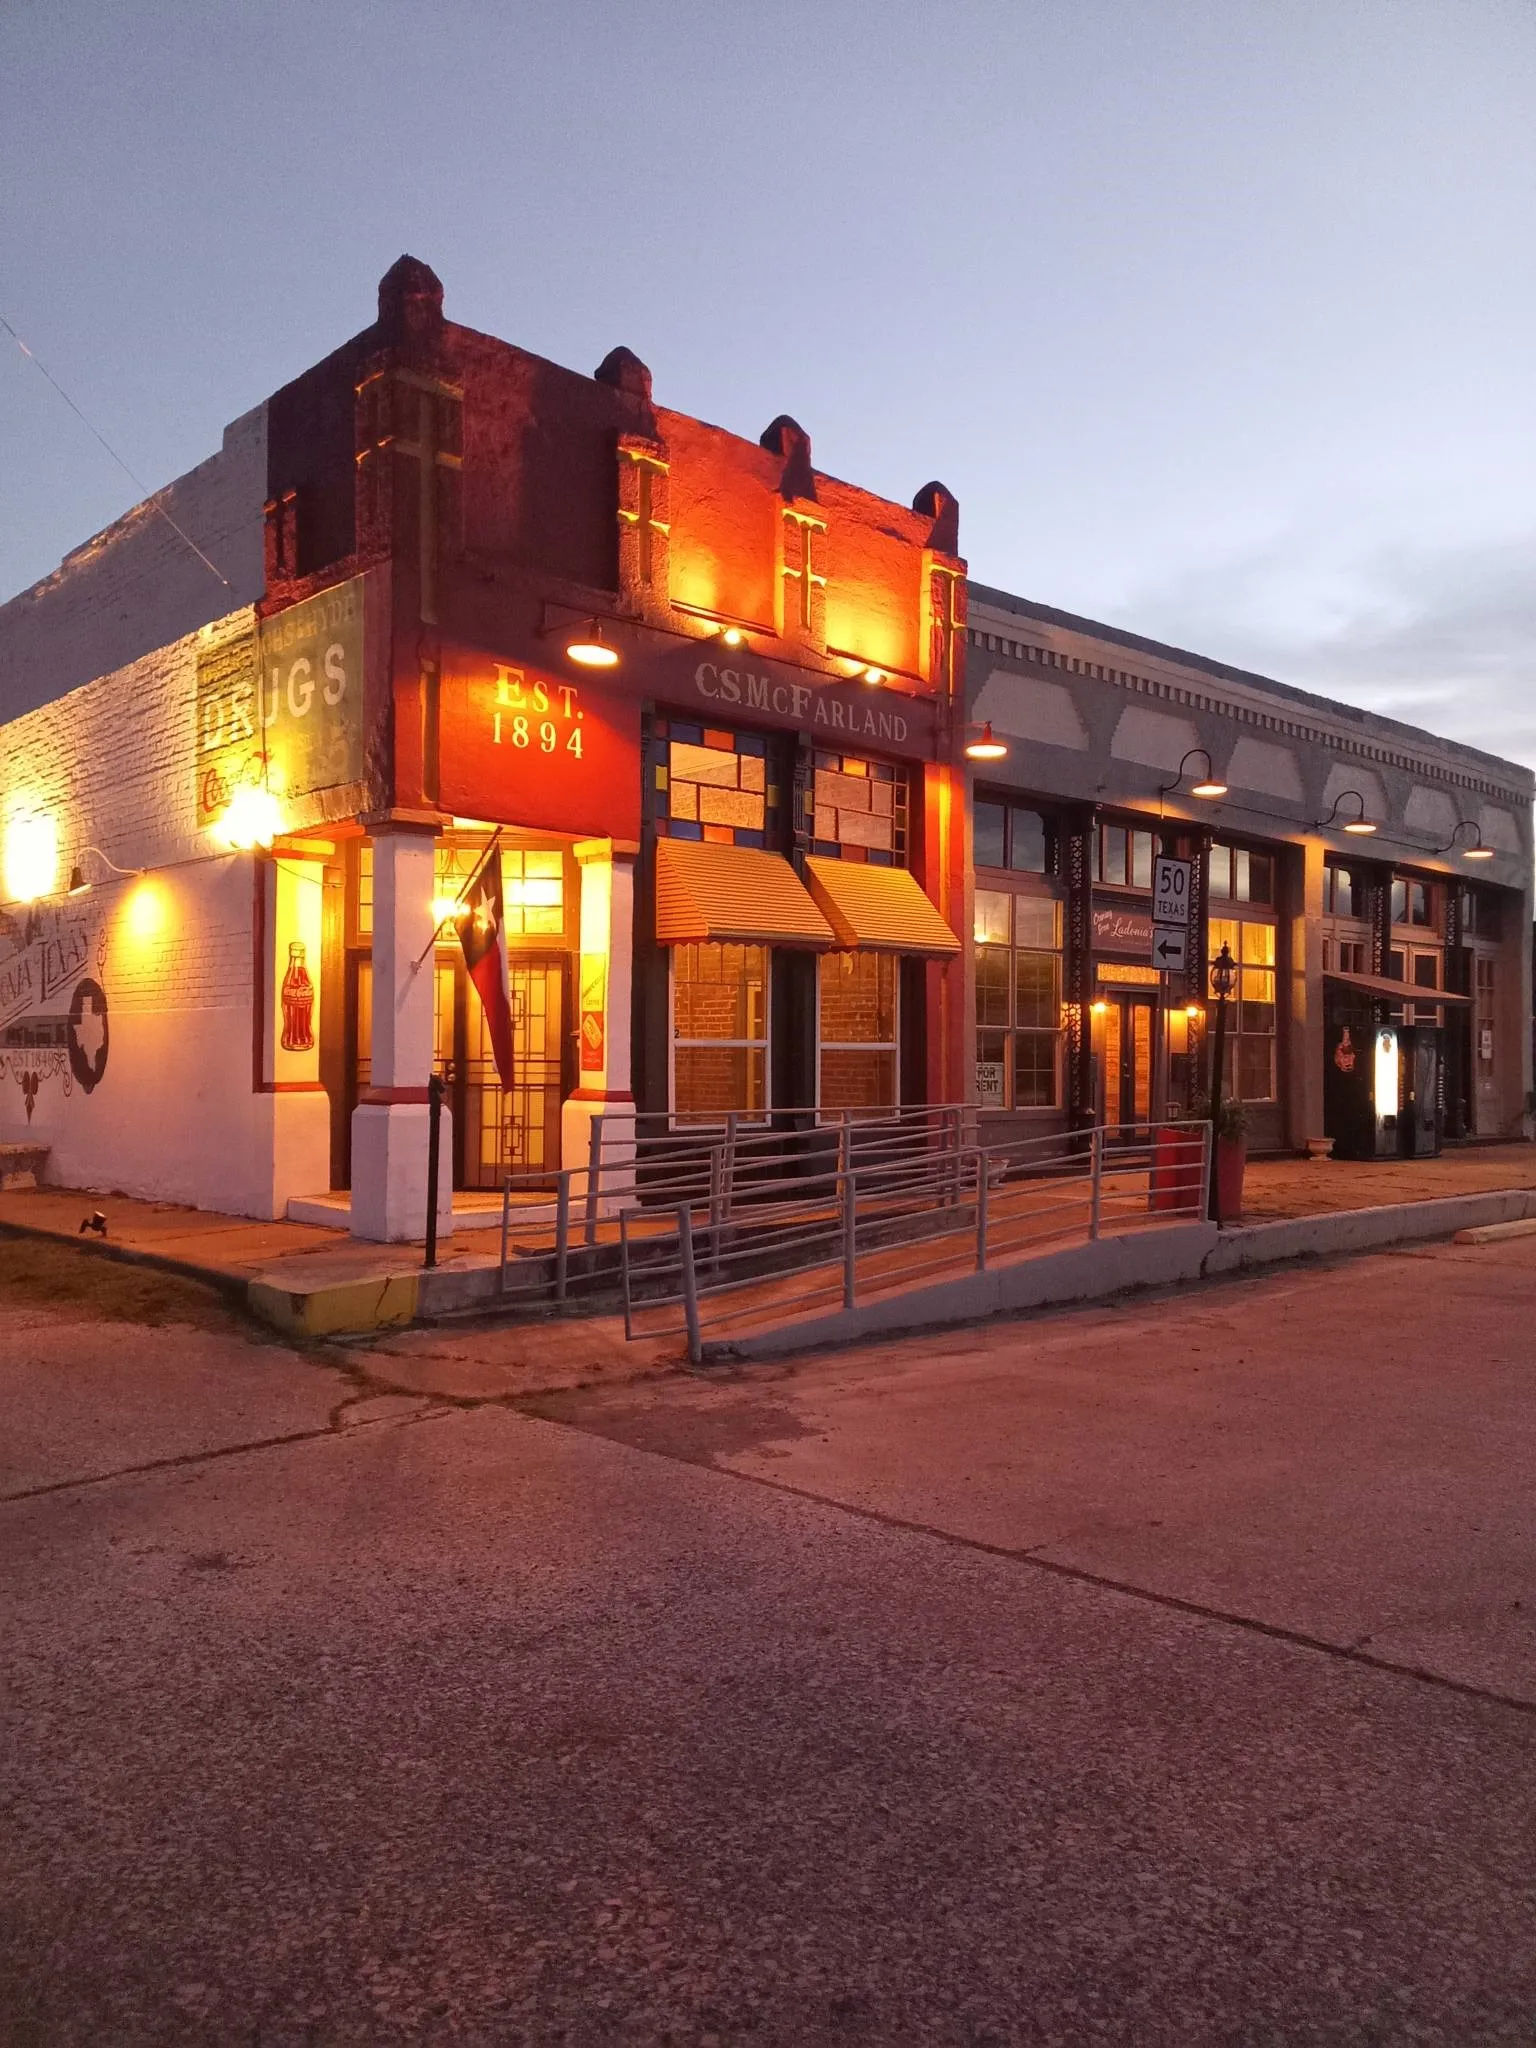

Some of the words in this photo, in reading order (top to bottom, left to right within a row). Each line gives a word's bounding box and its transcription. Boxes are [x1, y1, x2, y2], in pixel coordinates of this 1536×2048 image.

[203, 642, 346, 750] DRUGS
[493, 711, 584, 759] 1894
[1160, 866, 1185, 895] 50
[1158, 900, 1185, 916] TEXAS
